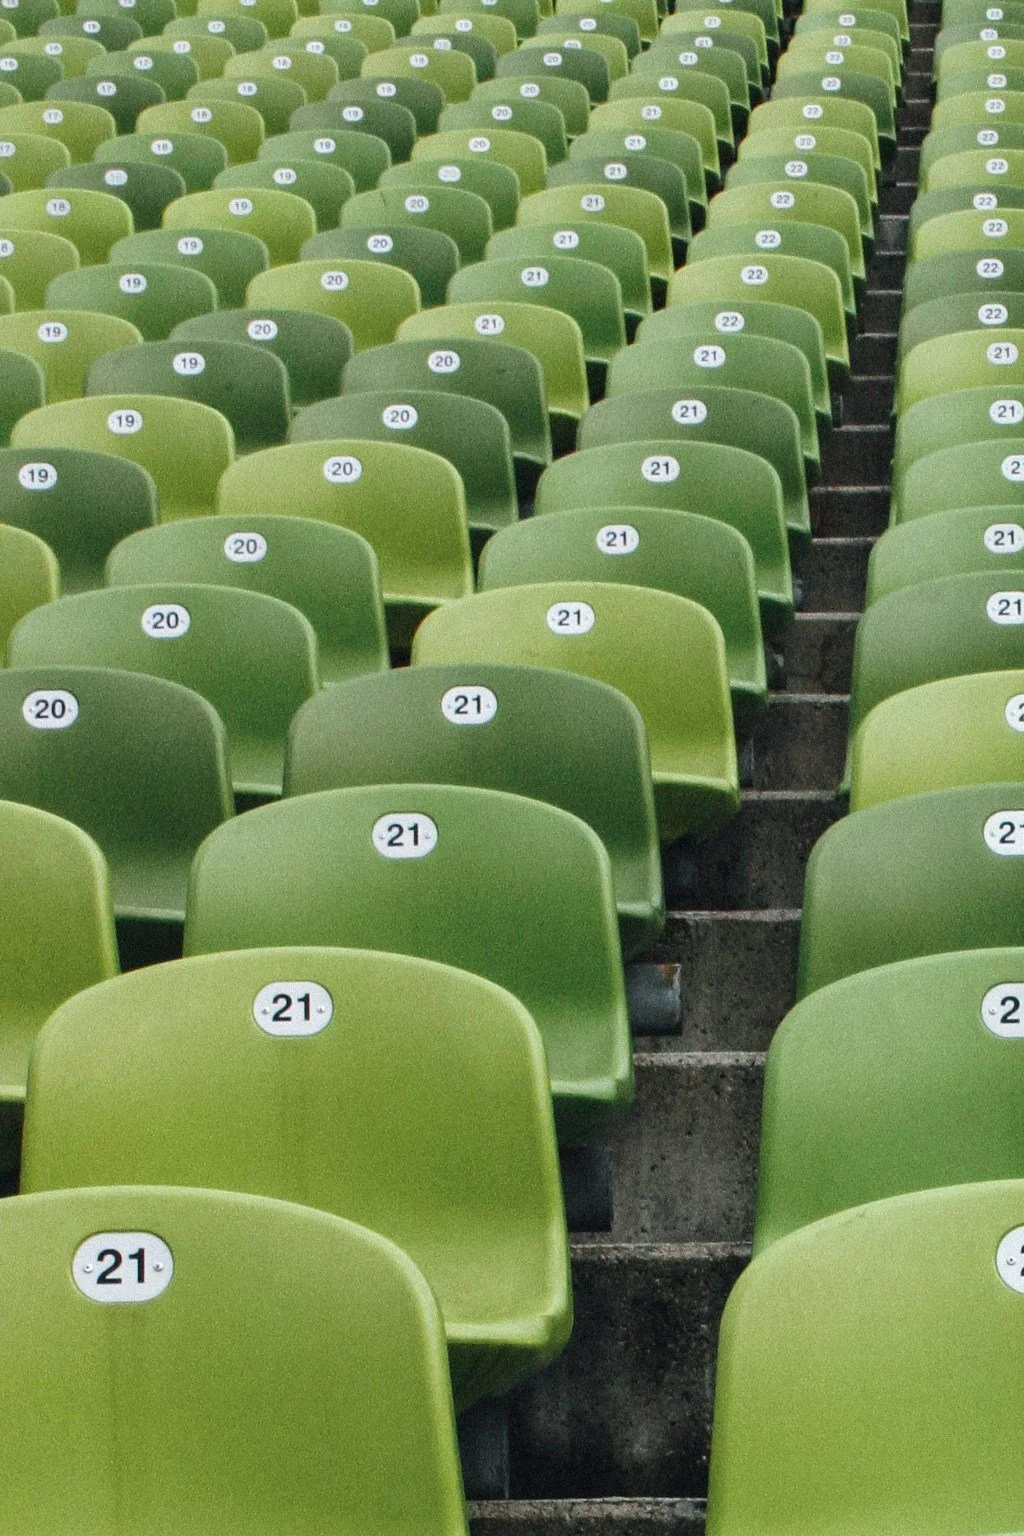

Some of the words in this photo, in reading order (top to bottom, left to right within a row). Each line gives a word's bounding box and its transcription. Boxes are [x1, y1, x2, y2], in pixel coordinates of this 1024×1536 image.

[347, 110, 359, 119] 19
[629, 138, 641, 147] 21
[609, 166, 622, 176] 21
[790, 163, 804, 173] 22
[279, 171, 293, 181] 19
[410, 198, 424, 209] 20
[586, 198, 599, 208] 21
[776, 194, 791, 205] 22
[978, 196, 993, 206] 22
[52, 202, 66, 212] 18
[234, 202, 248, 211] 19
[988, 222, 1003, 233] 22
[372, 238, 388, 249] 20
[559, 234, 573, 245] 21
[761, 234, 776, 244] 22
[184, 240, 198, 251] 19
[747, 268, 763, 280] 22
[982, 262, 999, 274] 22
[126, 277, 142, 288] 19
[327, 274, 344, 286] 20
[526, 271, 541, 282] 21
[985, 308, 1002, 320] 22
[481, 318, 497, 330] 21
[722, 315, 739, 328] 22
[45, 326, 62, 338] 19
[254, 323, 272, 335] 20
[700, 349, 717, 362] 21
[994, 346, 1010, 359] 21
[180, 357, 199, 370] 19
[435, 355, 454, 367] 20
[390, 409, 410, 423] 20
[680, 404, 697, 418] 21
[997, 405, 1015, 419] 21
[116, 414, 135, 428] 19
[331, 461, 354, 476] 20
[650, 461, 670, 476] 21
[28, 468, 49, 483] 19
[606, 531, 627, 547] 21
[993, 529, 1015, 546] 21
[233, 538, 258, 555] 20
[998, 598, 1022, 616] 21
[152, 611, 180, 630] 20
[557, 609, 581, 627] 21
[34, 698, 66, 719] 20
[454, 694, 481, 715] 21
[386, 822, 419, 847] 21
[271, 992, 311, 1022] 21
[96, 1247, 145, 1285] 21
